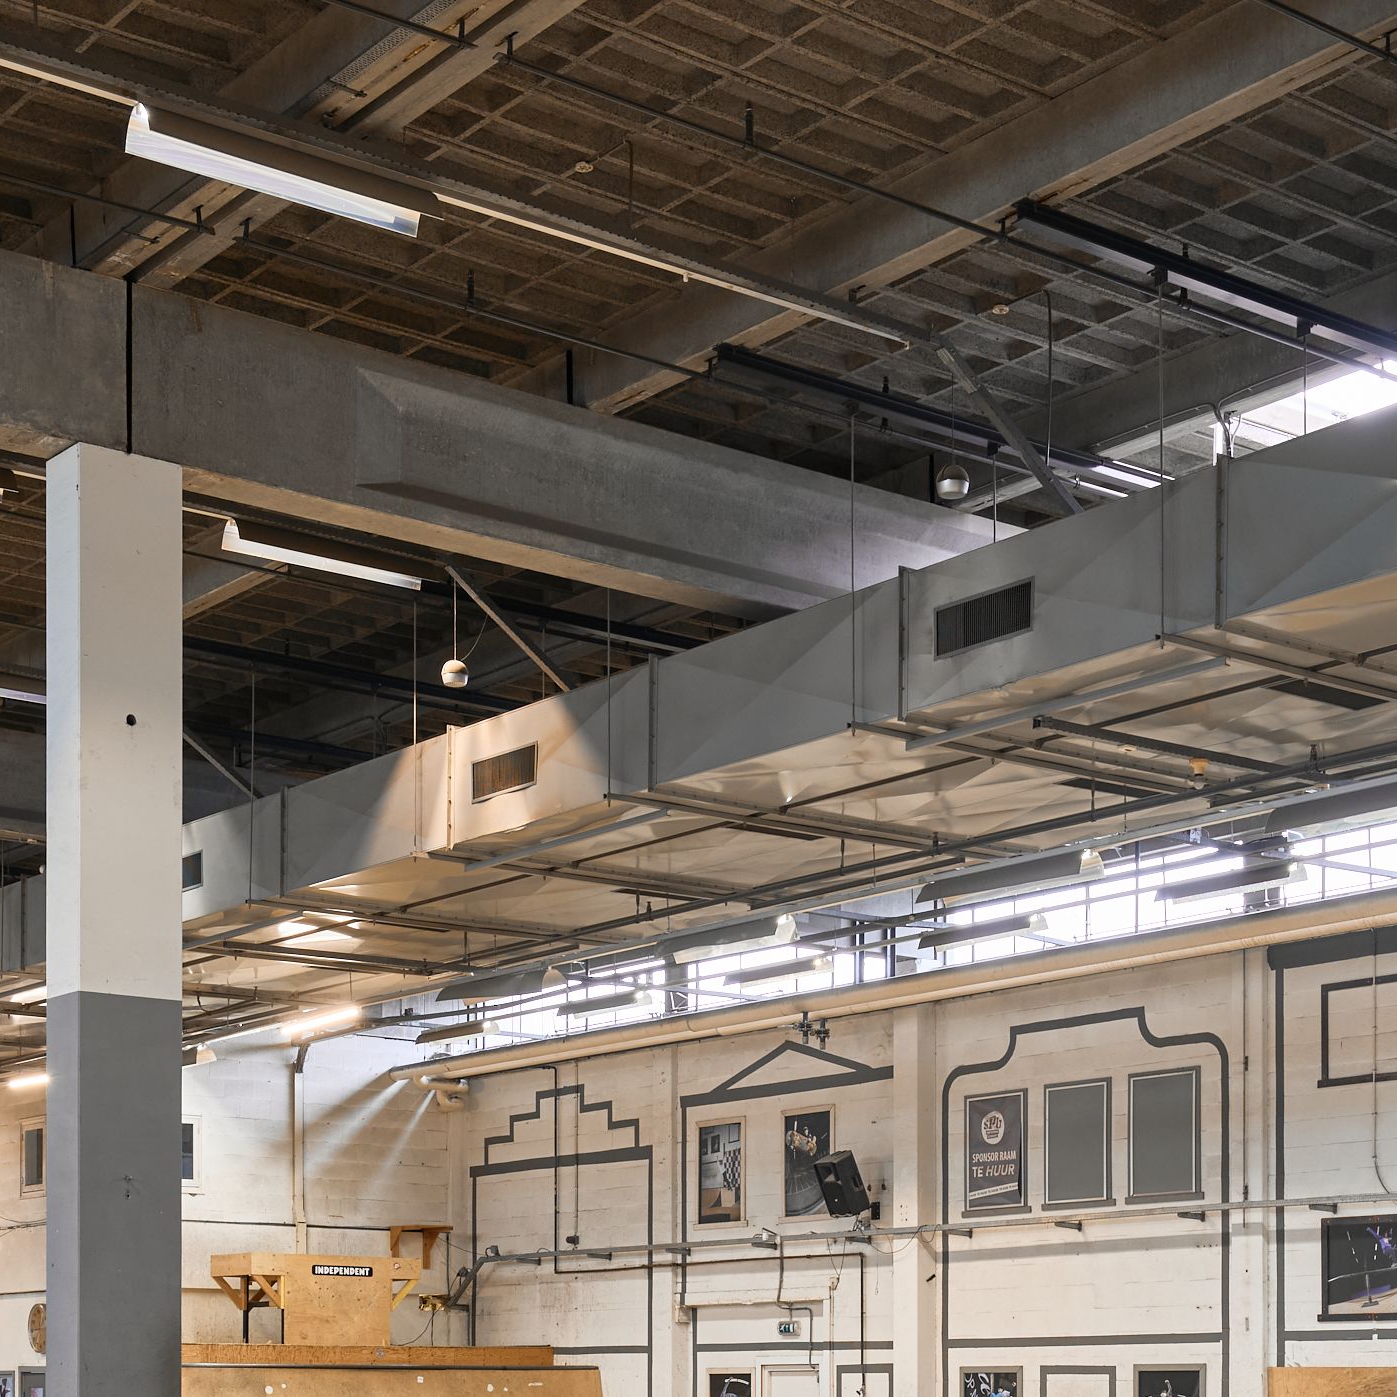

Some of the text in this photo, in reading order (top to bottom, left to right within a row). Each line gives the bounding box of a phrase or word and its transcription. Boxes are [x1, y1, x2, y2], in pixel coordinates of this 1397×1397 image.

[983, 1116, 1002, 1130] SPU
[972, 1150, 1017, 1163] SPONSOR RAAM
[972, 1164, 1015, 1178] TE HUUR
[314, 1265, 370, 1276] INDEPENDENT
